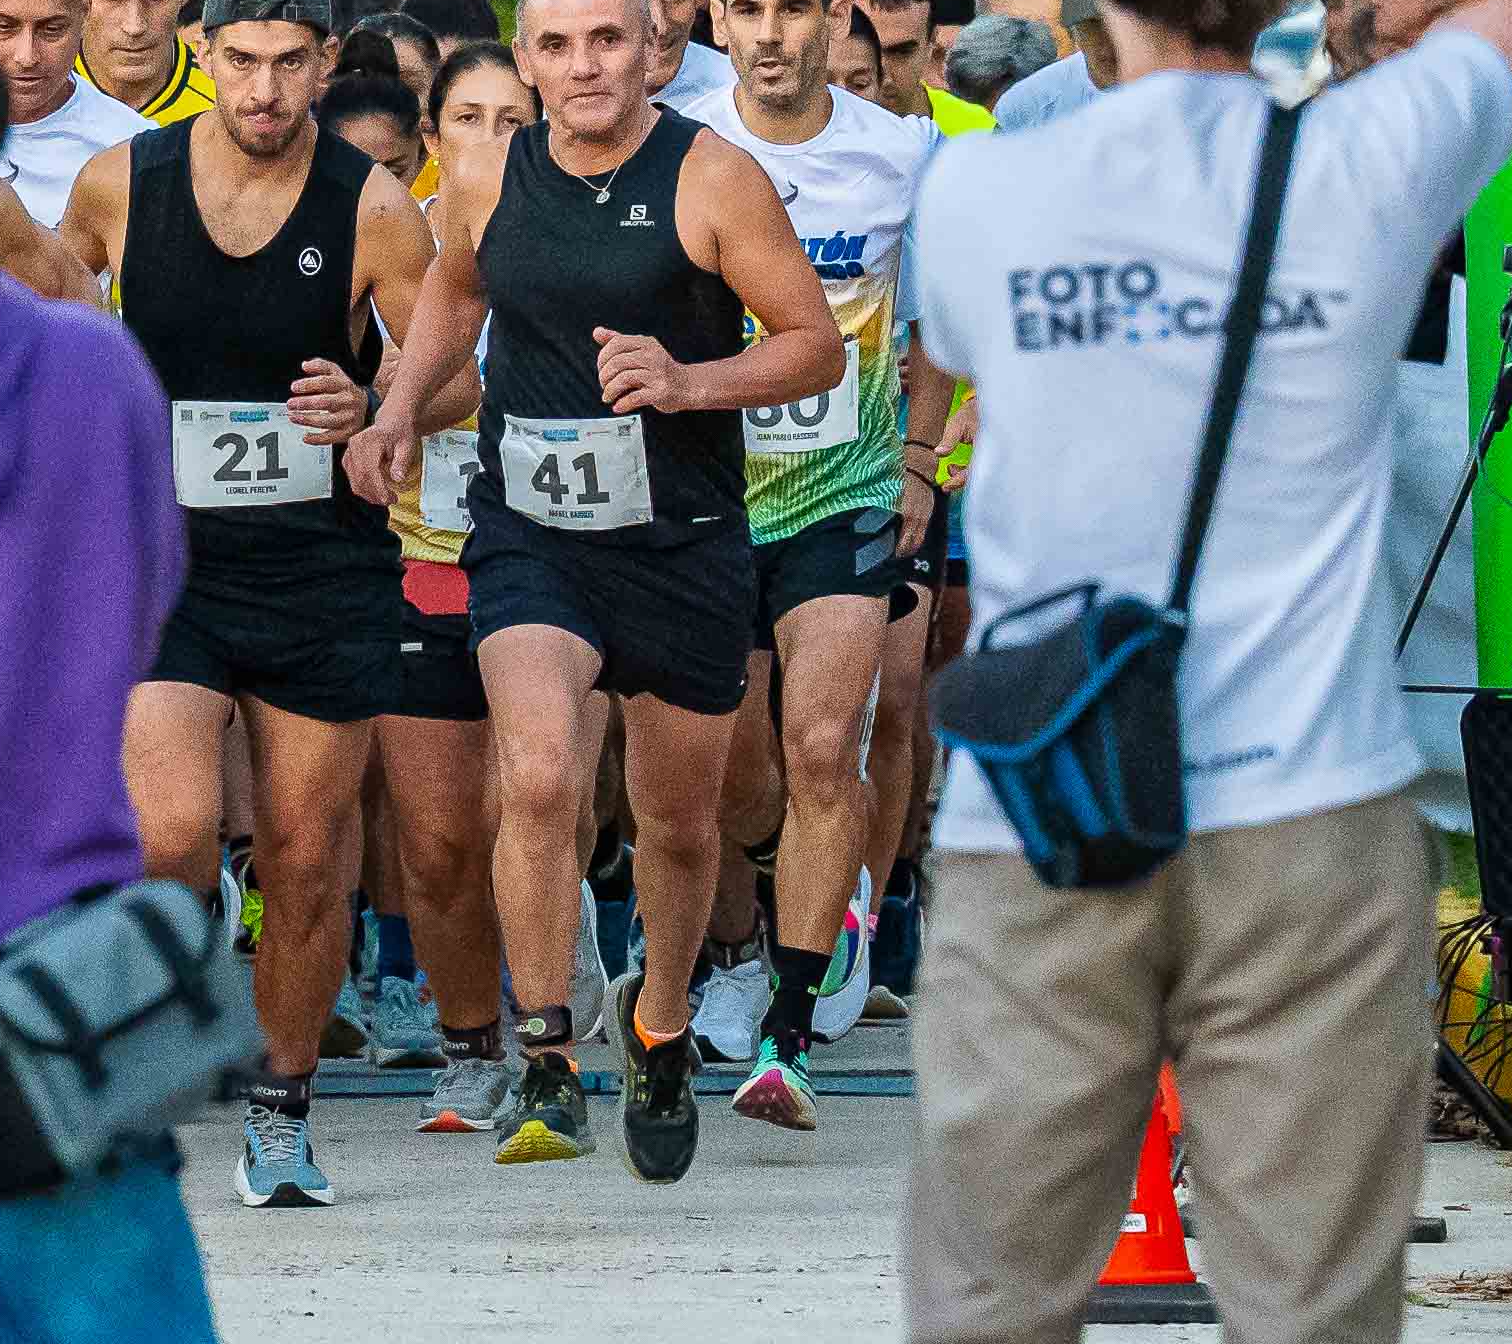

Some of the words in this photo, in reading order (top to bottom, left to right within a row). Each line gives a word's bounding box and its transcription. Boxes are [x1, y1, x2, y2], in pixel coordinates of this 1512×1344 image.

[1008, 262, 1160, 308] FOTO
[212, 432, 289, 482] 21
[531, 451, 610, 506] 41
[226, 486, 249, 495] LEONEL
[249, 485, 278, 495] PEREYRA
